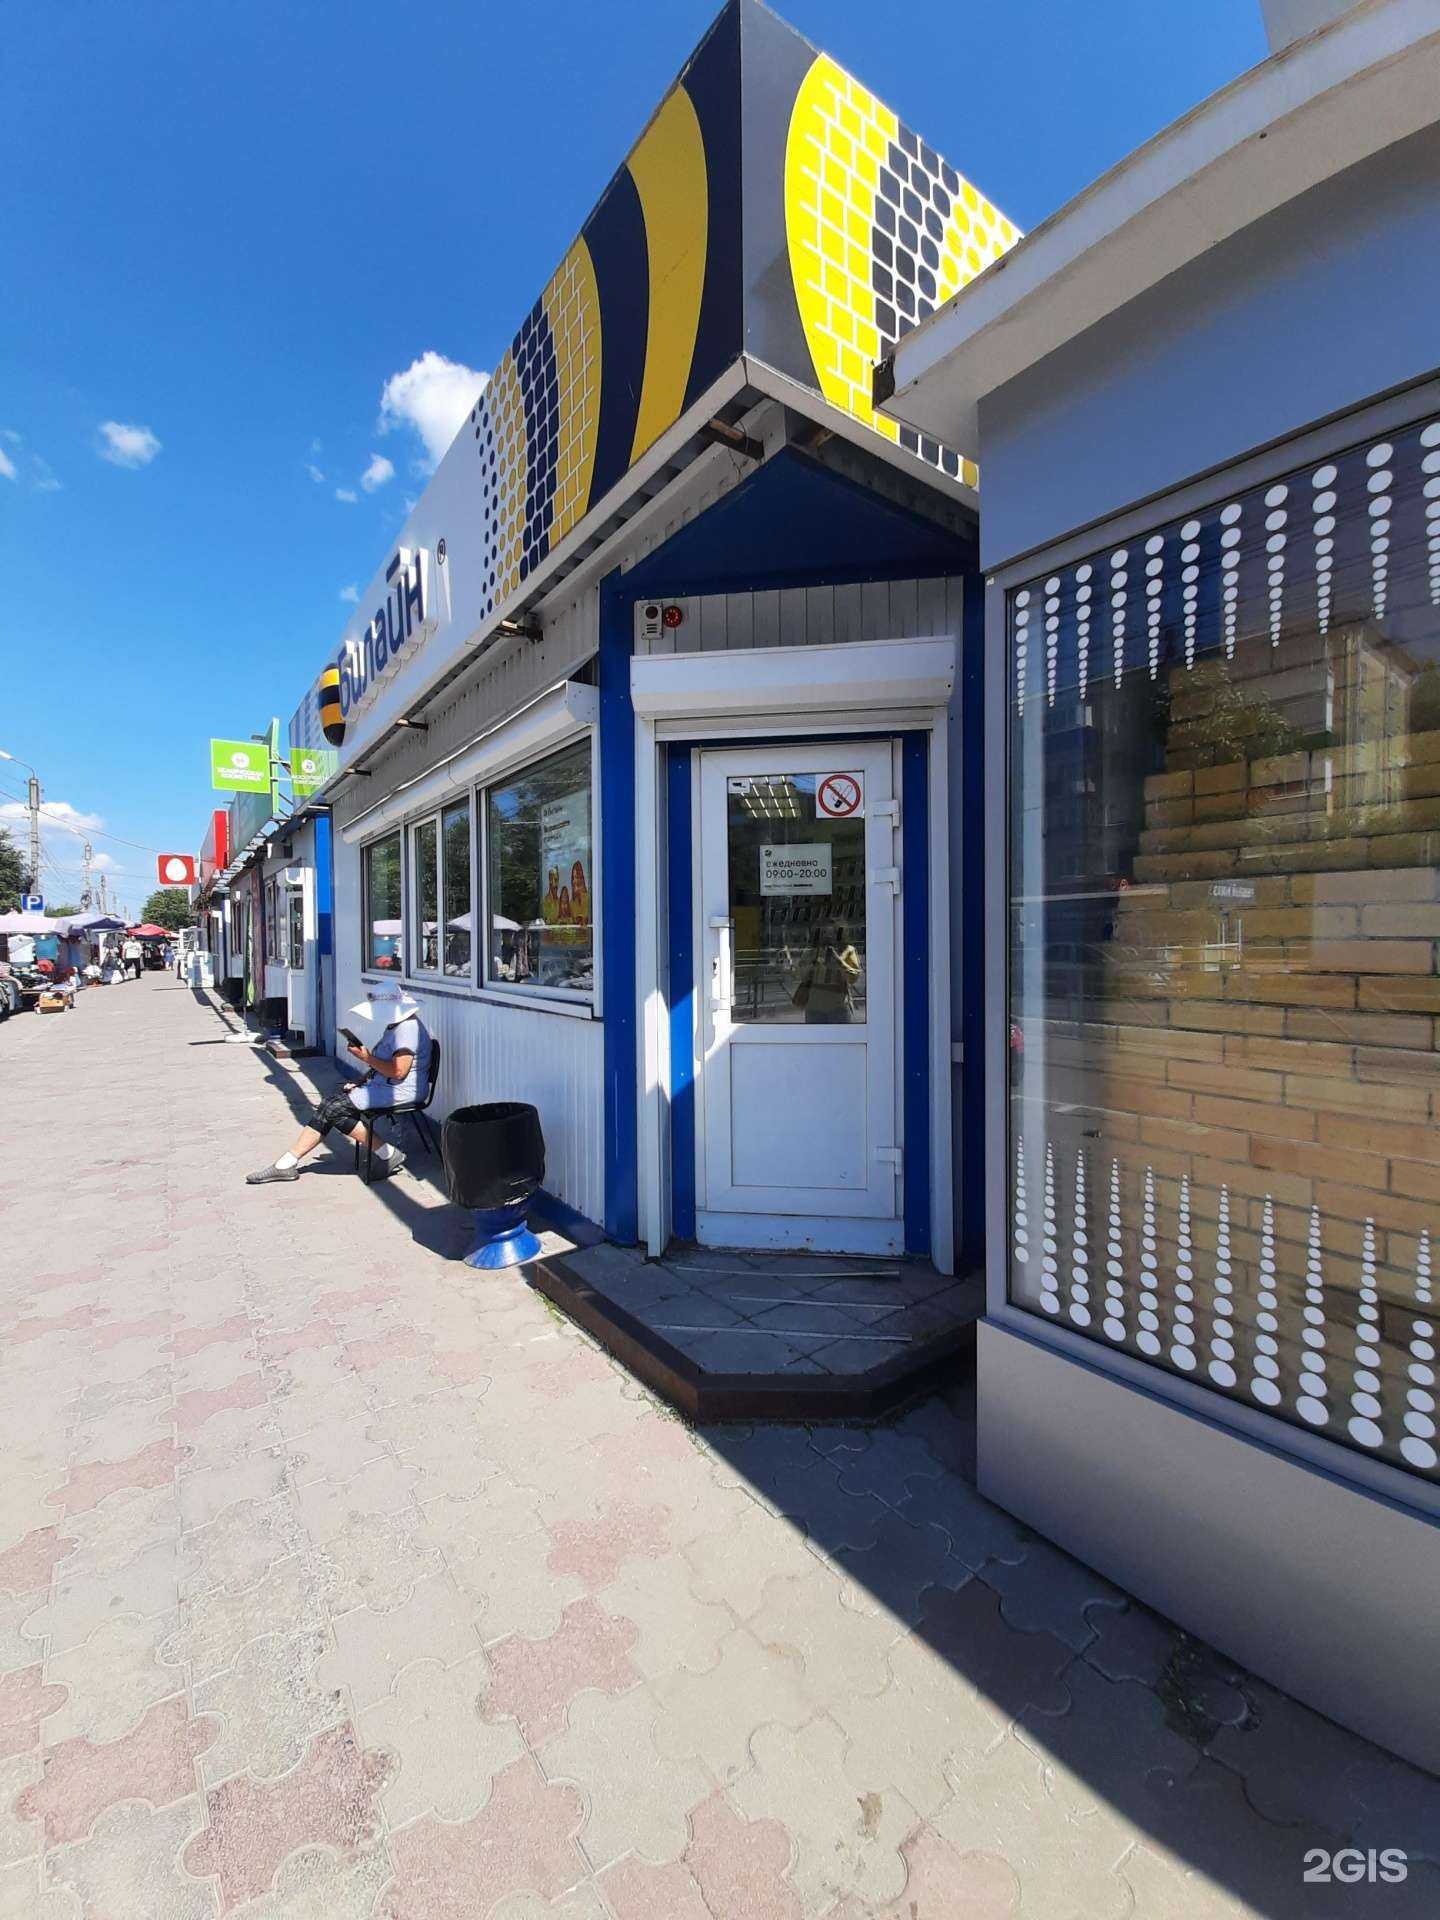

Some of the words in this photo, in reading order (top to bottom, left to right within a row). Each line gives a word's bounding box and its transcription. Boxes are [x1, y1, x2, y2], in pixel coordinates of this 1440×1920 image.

[337, 550, 425, 718] билайн
[766, 860, 818, 868] ежедневно
[26, 896, 40, 911] P
